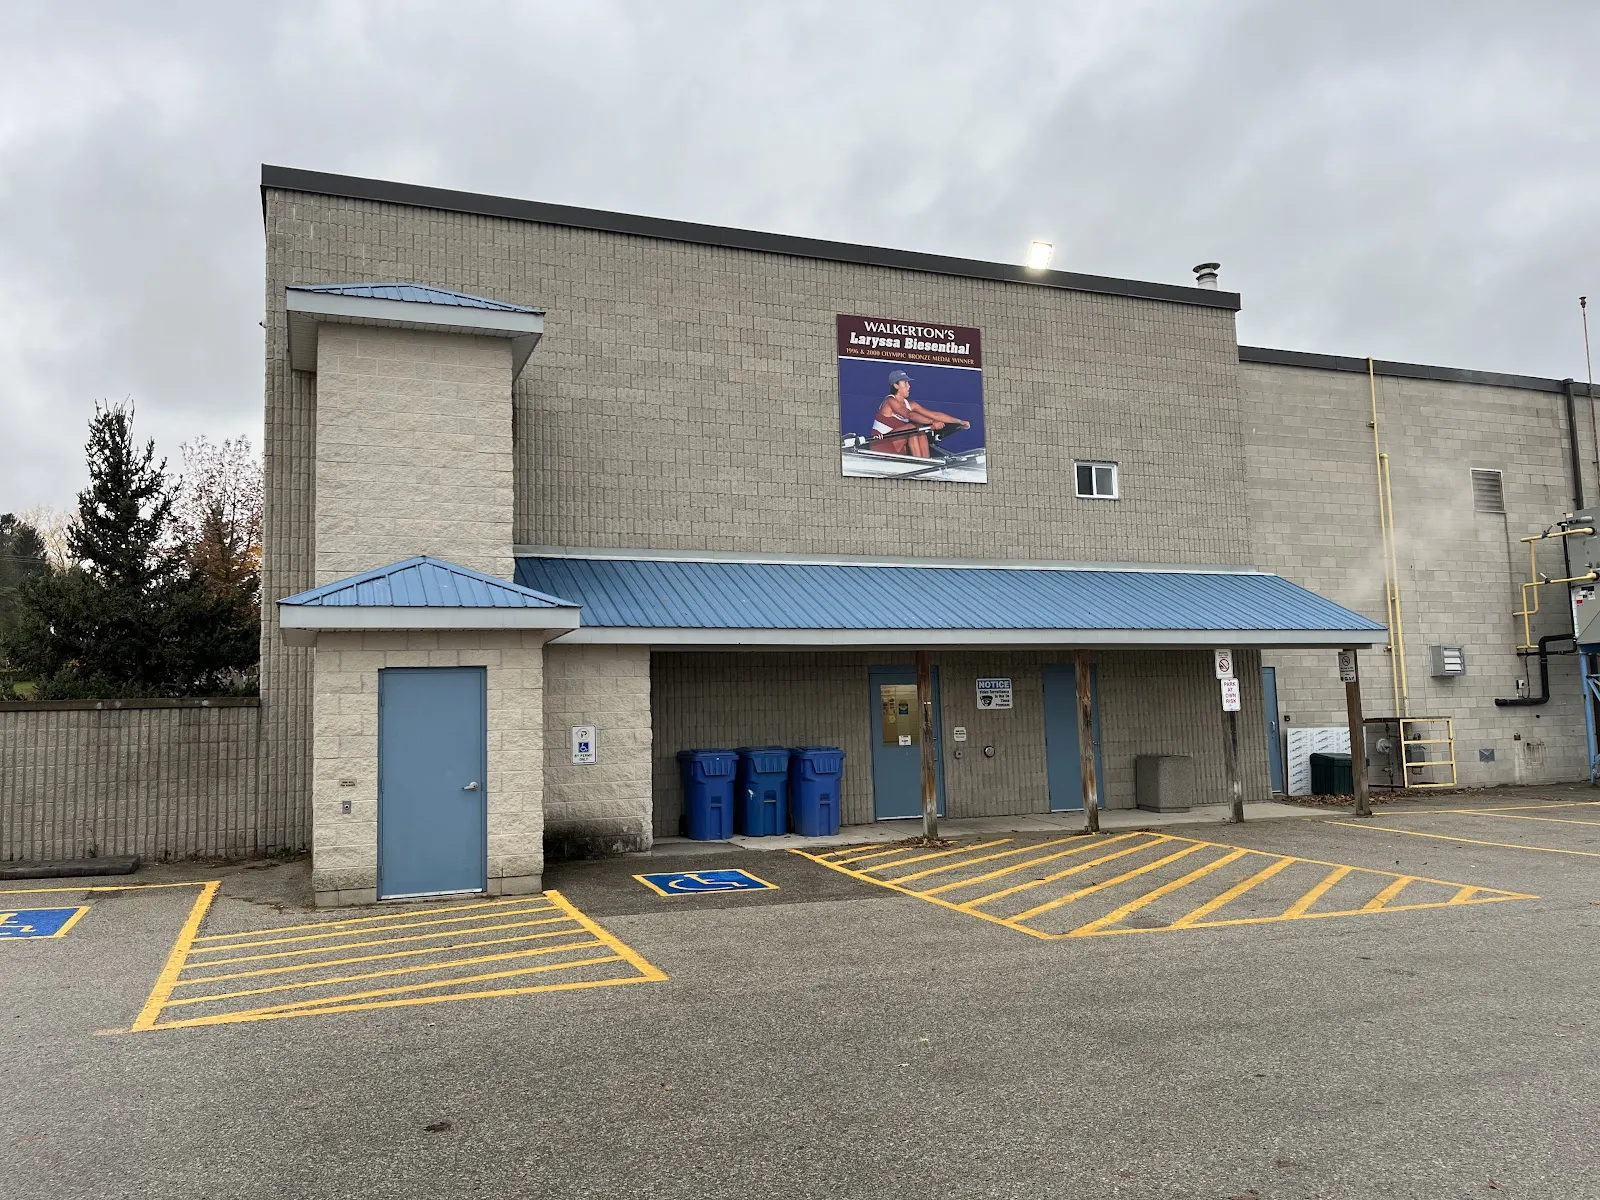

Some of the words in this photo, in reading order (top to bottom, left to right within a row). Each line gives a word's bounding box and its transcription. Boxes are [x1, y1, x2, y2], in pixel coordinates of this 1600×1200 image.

[864, 321, 955, 340] WALKERTON'S
[850, 332, 901, 348] Laryssa
[904, 337, 970, 355] Biesenthal
[881, 351, 906, 359] OLYMPIC
[908, 353, 930, 361] BRONZE
[932, 355, 950, 363] MEDAL
[952, 357, 974, 365] WINNER
[978, 681, 1010, 689] NOTICE
